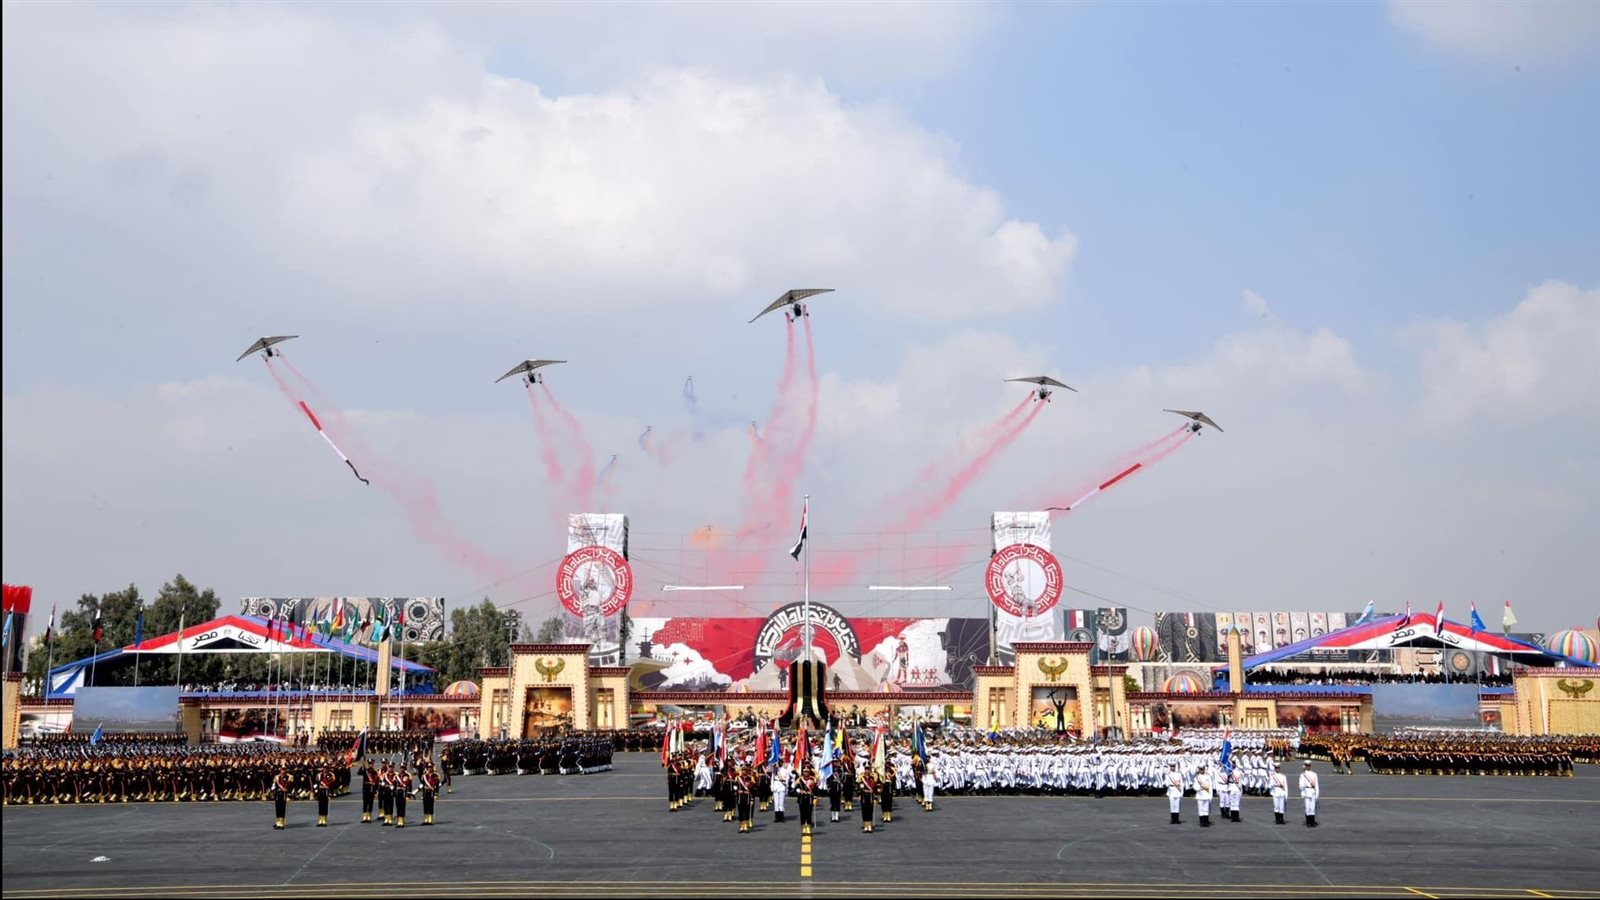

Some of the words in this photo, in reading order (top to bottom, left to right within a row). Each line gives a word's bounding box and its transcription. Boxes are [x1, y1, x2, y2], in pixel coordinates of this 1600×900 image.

[192, 631, 218, 646] مصر
[238, 631, 261, 645] تحيا
[1389, 628, 1415, 644] مصر
